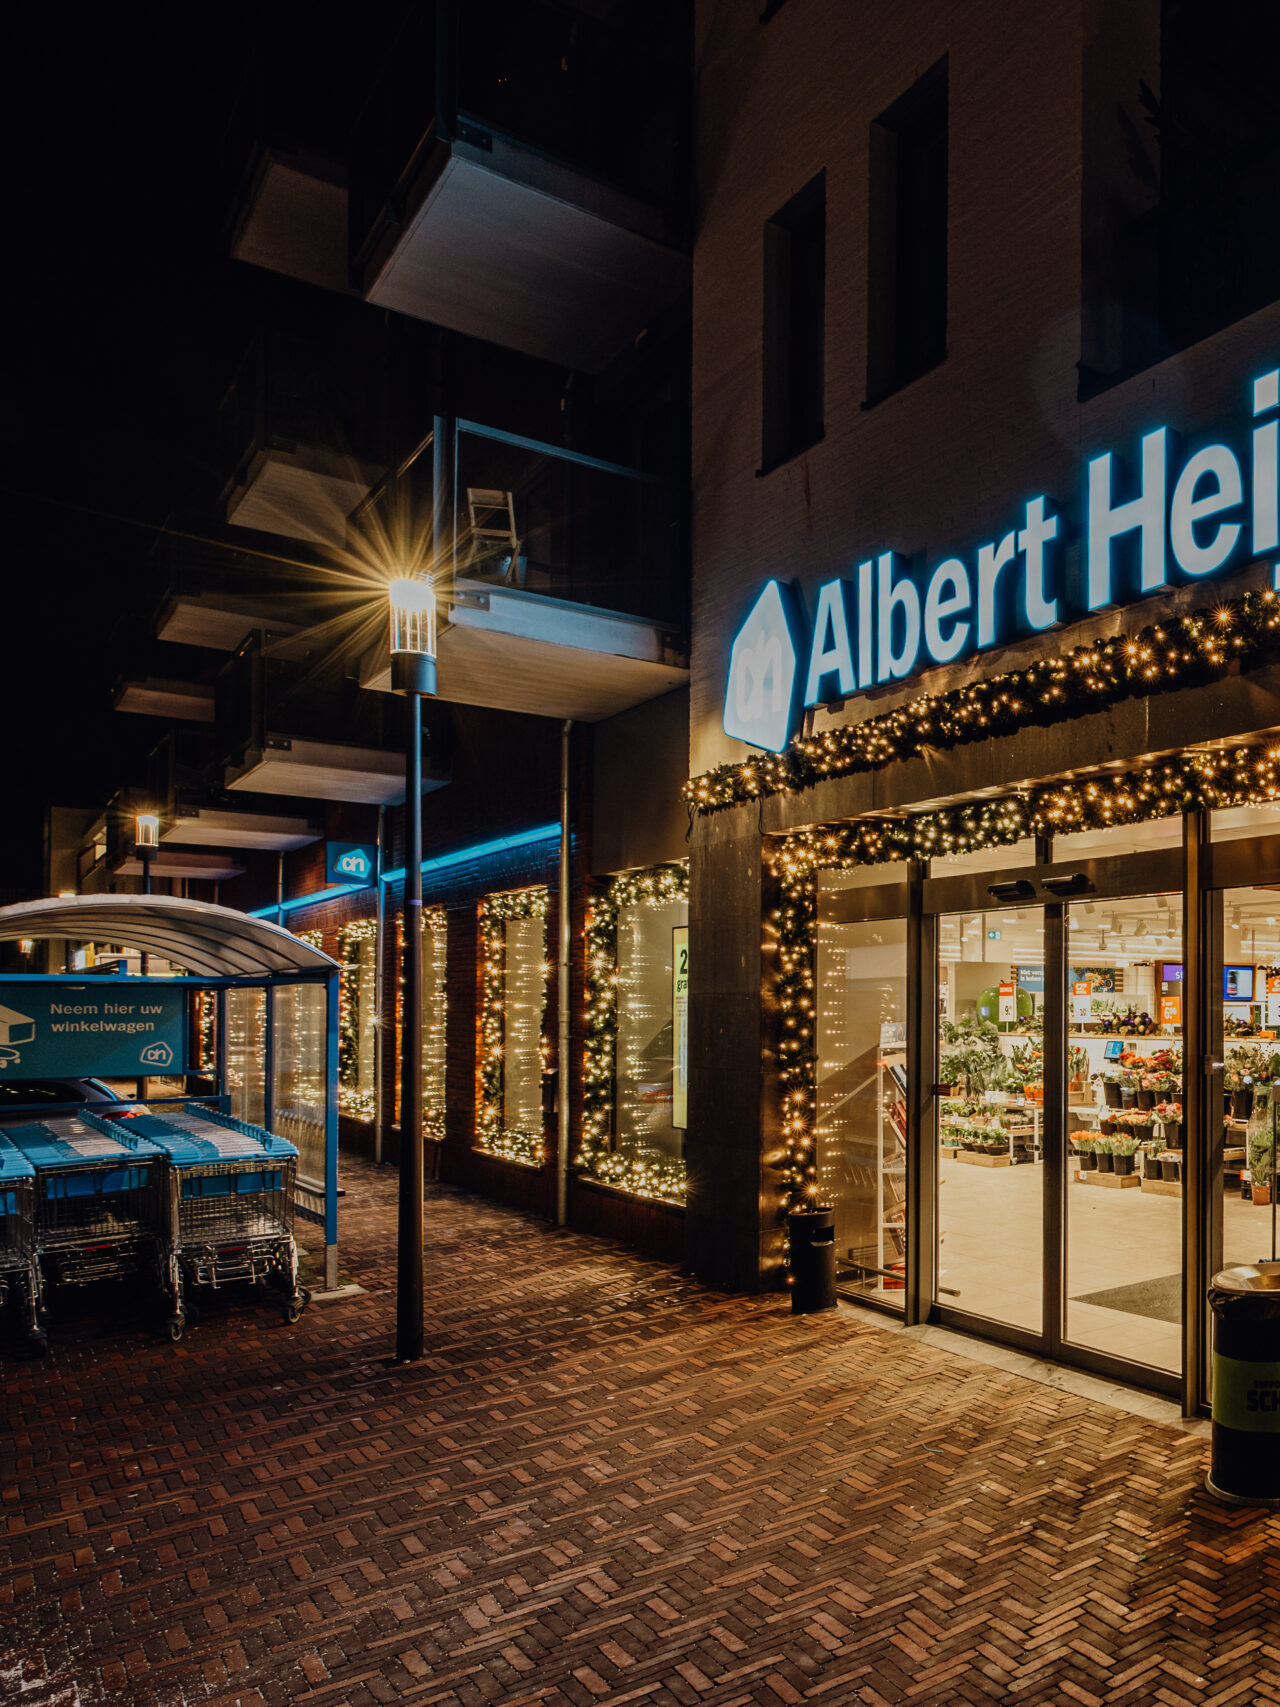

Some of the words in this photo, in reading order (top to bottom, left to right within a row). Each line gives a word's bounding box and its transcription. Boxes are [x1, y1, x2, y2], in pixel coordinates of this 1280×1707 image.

[804, 494, 1060, 707] Albert
[50, 1003, 98, 1015] Neem
[104, 1003, 135, 1014] hier
[140, 1005, 163, 1014] uw
[51, 1021, 155, 1034] winkelwagen
